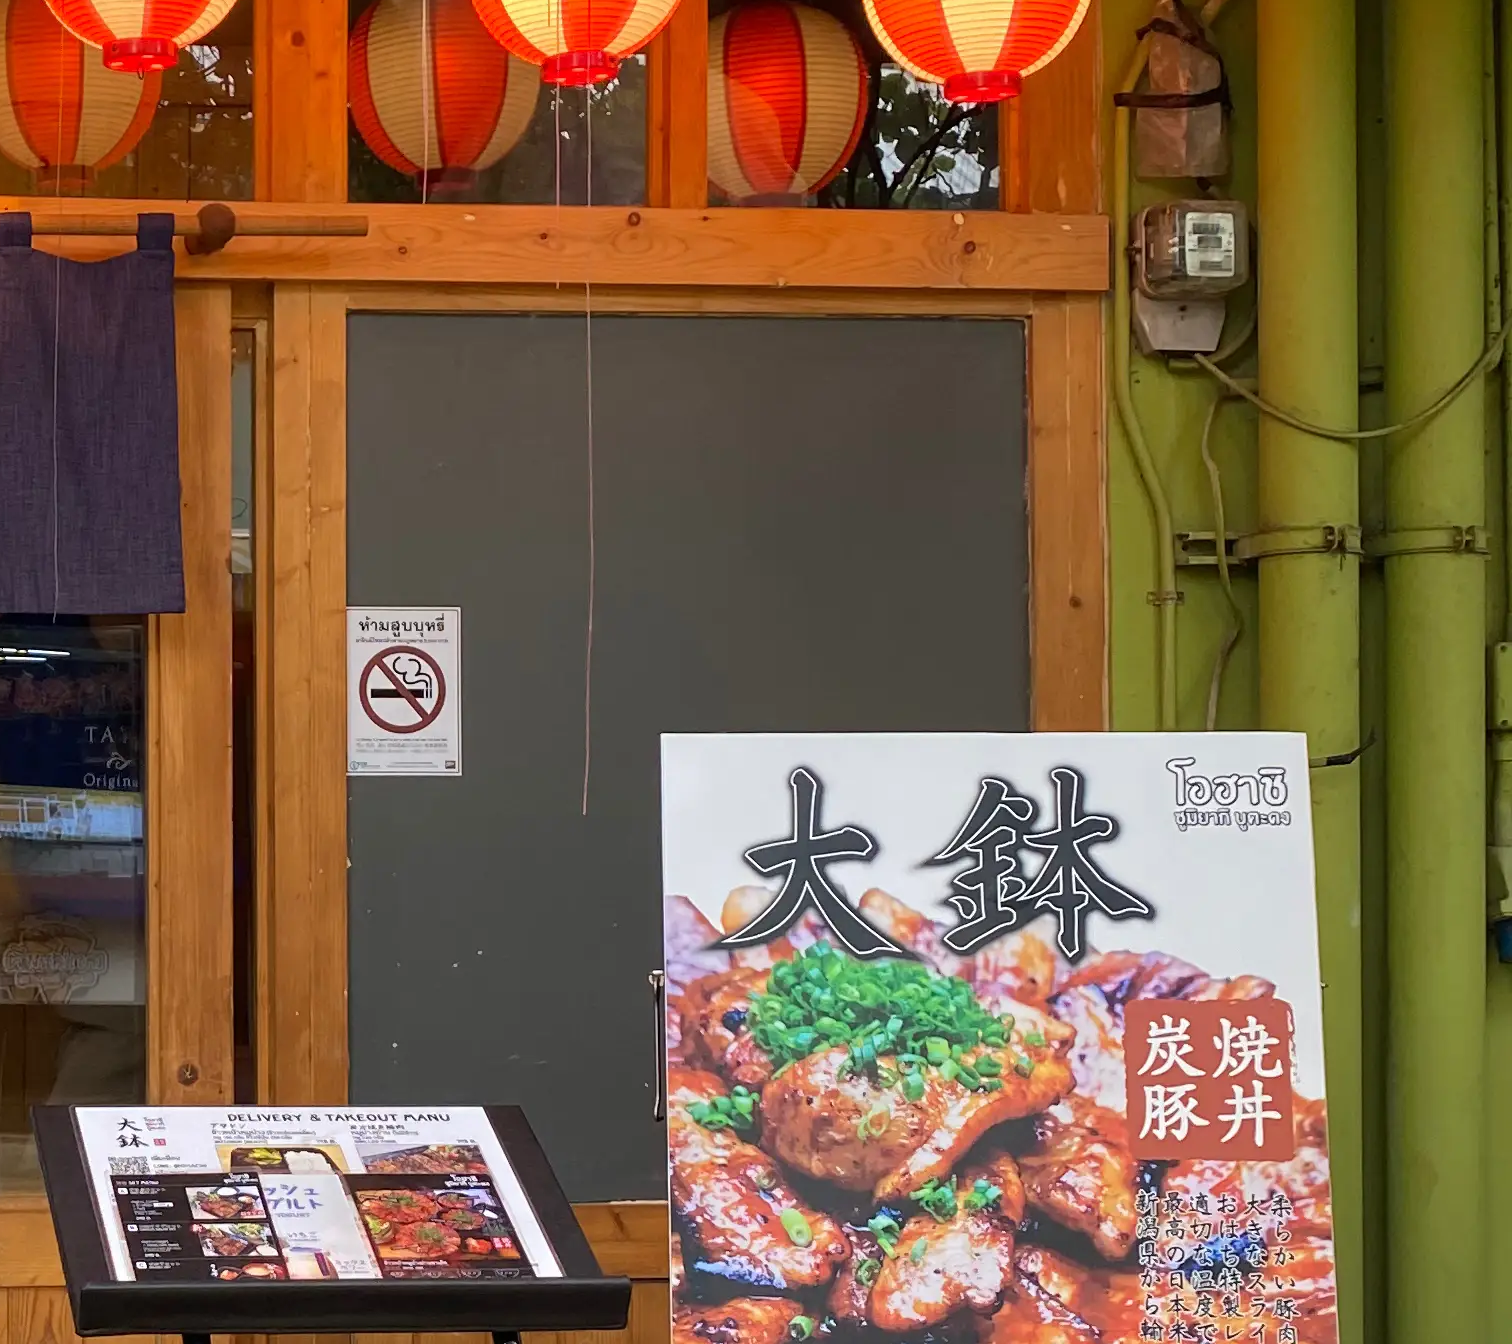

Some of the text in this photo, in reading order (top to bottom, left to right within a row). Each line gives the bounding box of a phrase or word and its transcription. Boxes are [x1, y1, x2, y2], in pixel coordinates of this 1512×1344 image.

[358, 613, 445, 637] ห้ามสูบบุหรี่
[1166, 756, 1288, 806] โอฮาชิ
[227, 1113, 451, 1122] DELIVERY & TAKEOUT MANU
